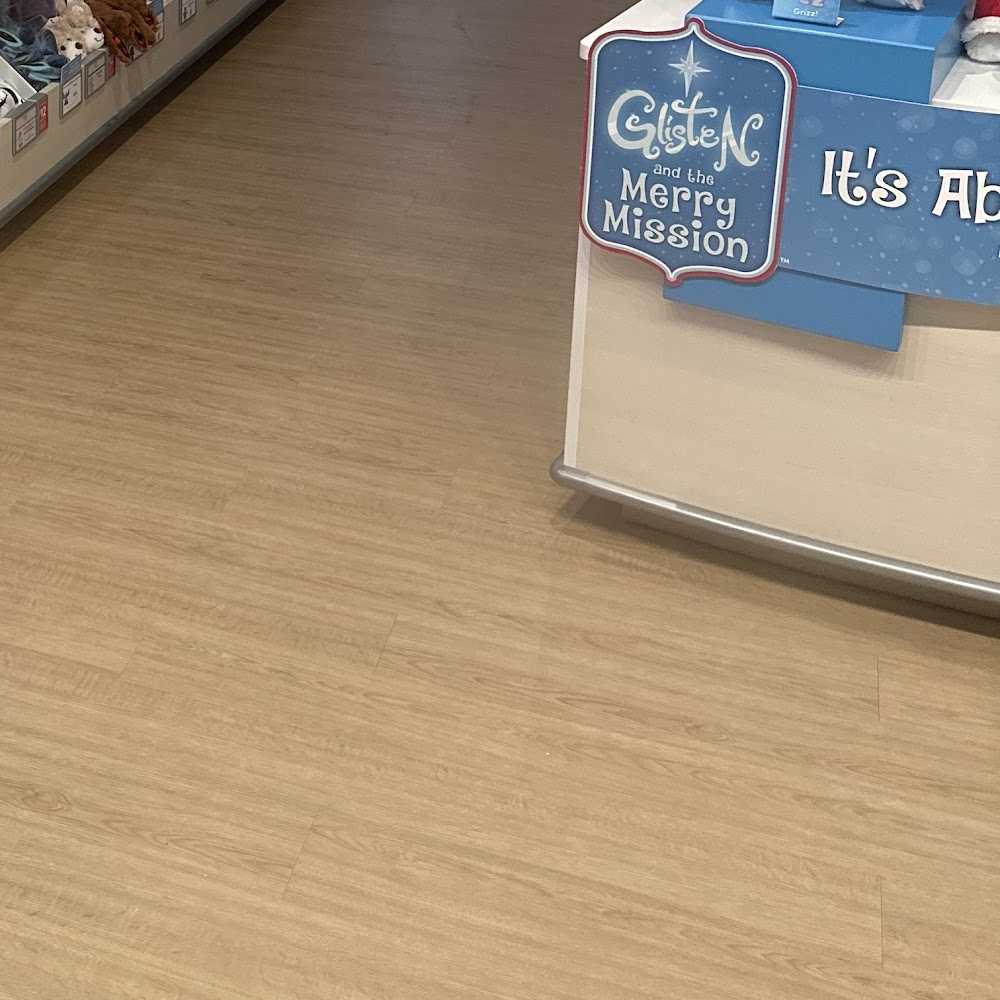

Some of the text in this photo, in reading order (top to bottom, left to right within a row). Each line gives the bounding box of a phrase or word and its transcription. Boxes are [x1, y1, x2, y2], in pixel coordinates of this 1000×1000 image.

[793, 7, 819, 17] Grizz!
[621, 167, 737, 231] Merry
[653, 163, 714, 186] and the
[821, 147, 1000, 224] It's Ab
[602, 200, 750, 264] Mission
